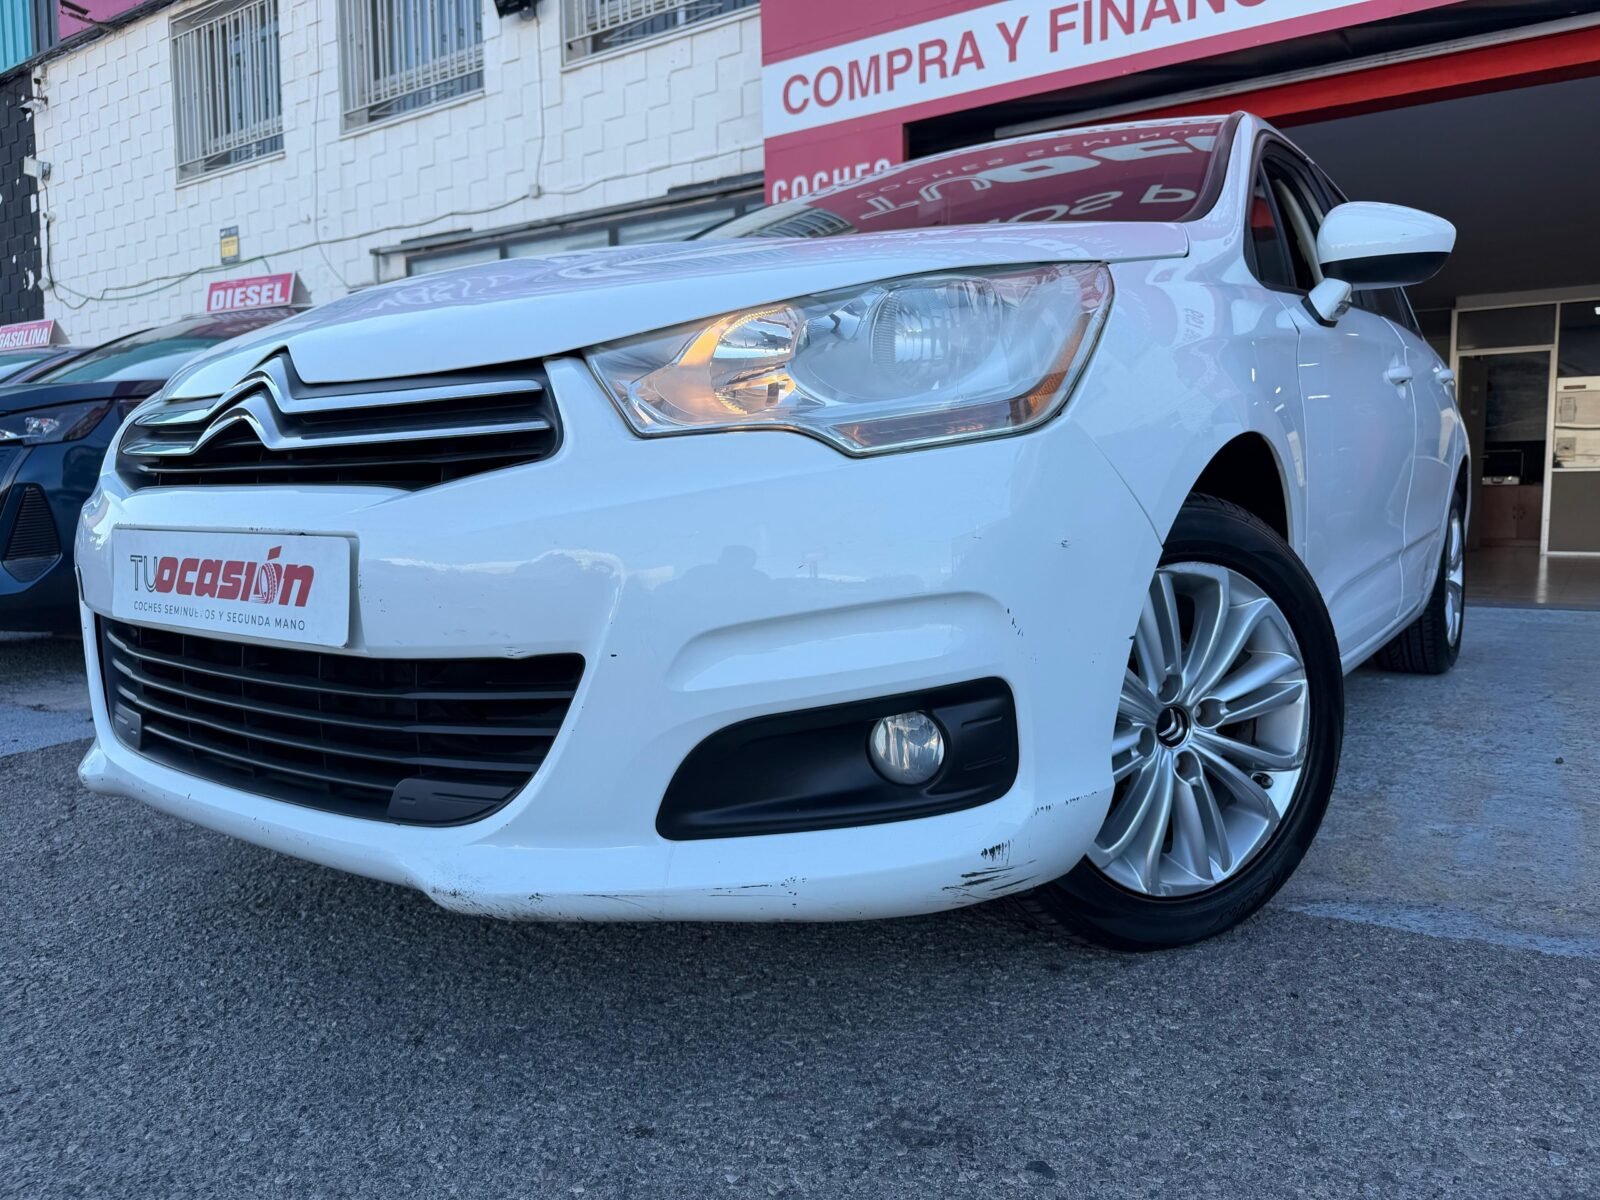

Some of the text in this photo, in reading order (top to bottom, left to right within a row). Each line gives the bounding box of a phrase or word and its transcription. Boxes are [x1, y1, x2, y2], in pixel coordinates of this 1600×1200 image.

[782, 0, 1267, 116] COMPRA Y FINA
[209, 282, 286, 311] DIESEL
[133, 600, 306, 631] COCHES SEMINUEOS Y SEGUNDA MANO
